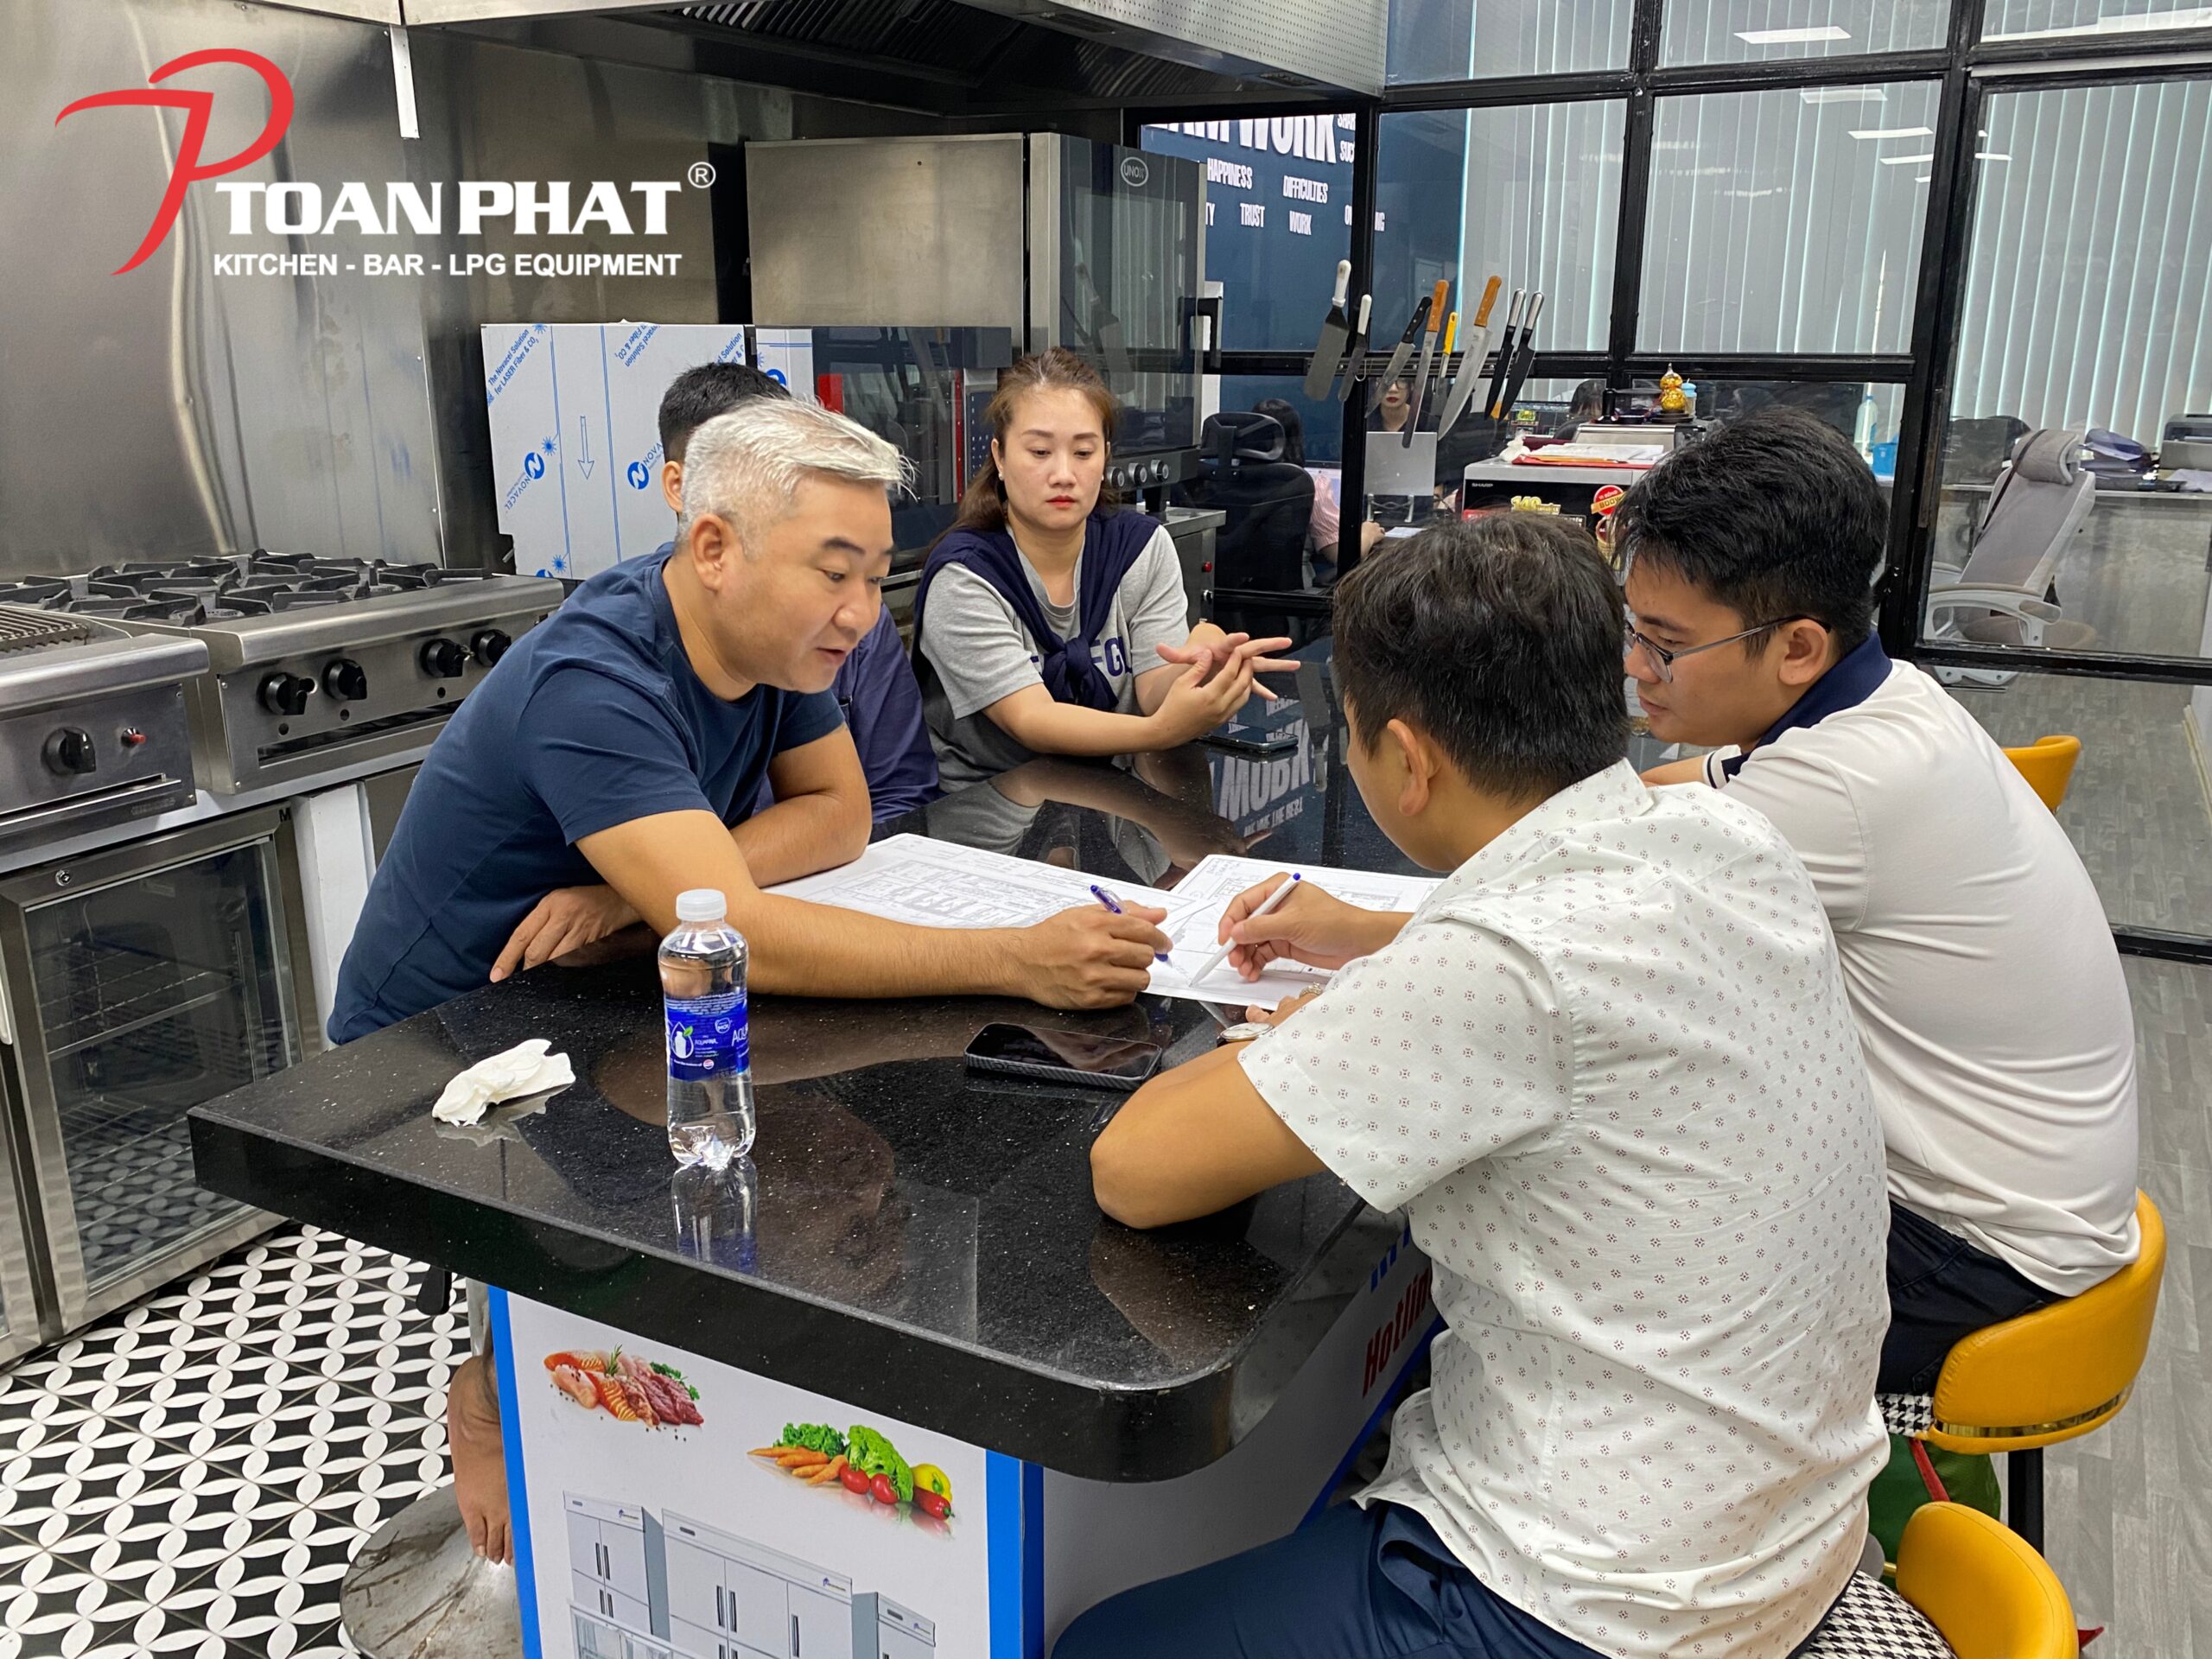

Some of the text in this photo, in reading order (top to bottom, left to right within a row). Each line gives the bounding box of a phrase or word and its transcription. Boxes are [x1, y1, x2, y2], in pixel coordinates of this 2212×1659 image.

[1206, 157, 1253, 190] HAPPINESS
[1282, 175, 1329, 204] DIFFICULTIES
[1239, 202, 1265, 228] TRUST
[1288, 209, 1313, 236] WORK
[487, 329, 530, 386] The Novacel Solution
[721, 332, 742, 359] Solution
[500, 365, 516, 386] LASER
[513, 351, 526, 368] Fiber
[643, 442, 663, 467] NOVA
[1362, 1268, 1433, 1399] Hotlin
